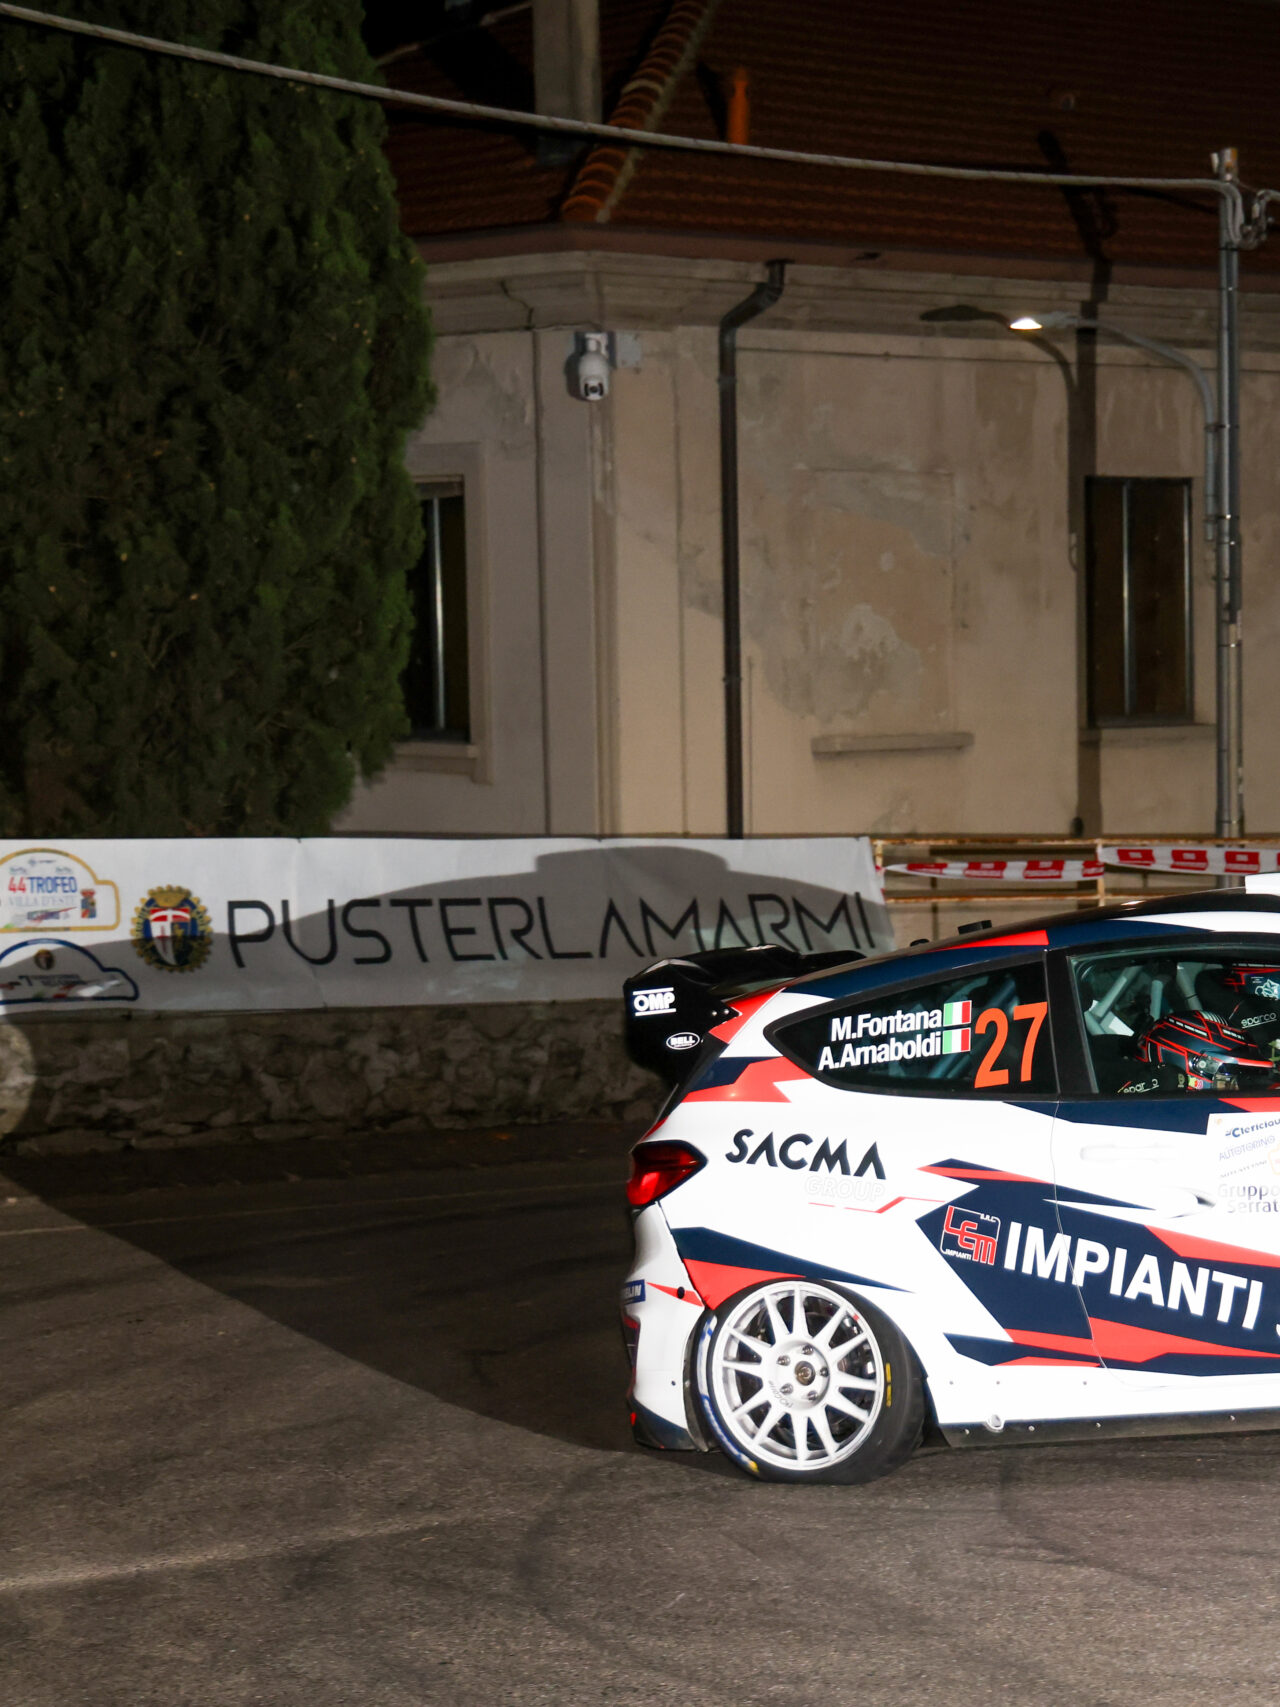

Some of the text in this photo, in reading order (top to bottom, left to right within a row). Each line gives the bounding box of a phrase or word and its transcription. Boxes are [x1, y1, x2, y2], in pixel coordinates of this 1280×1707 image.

[8, 876, 78, 893] 44 TROFEO
[633, 991, 675, 1012] OMP
[831, 1009, 942, 1042] M.Fontana
[1241, 1012, 1277, 1028] sparco
[670, 1035, 696, 1046] BELL
[817, 1030, 942, 1071] A.Arnaboldi
[974, 1001, 1048, 1088] 27
[725, 1128, 887, 1180] SACMA
[805, 1176, 886, 1201] GROUP
[1217, 1184, 1280, 1200] Gruppo
[1003, 1221, 1263, 1329] IMPIANTI
